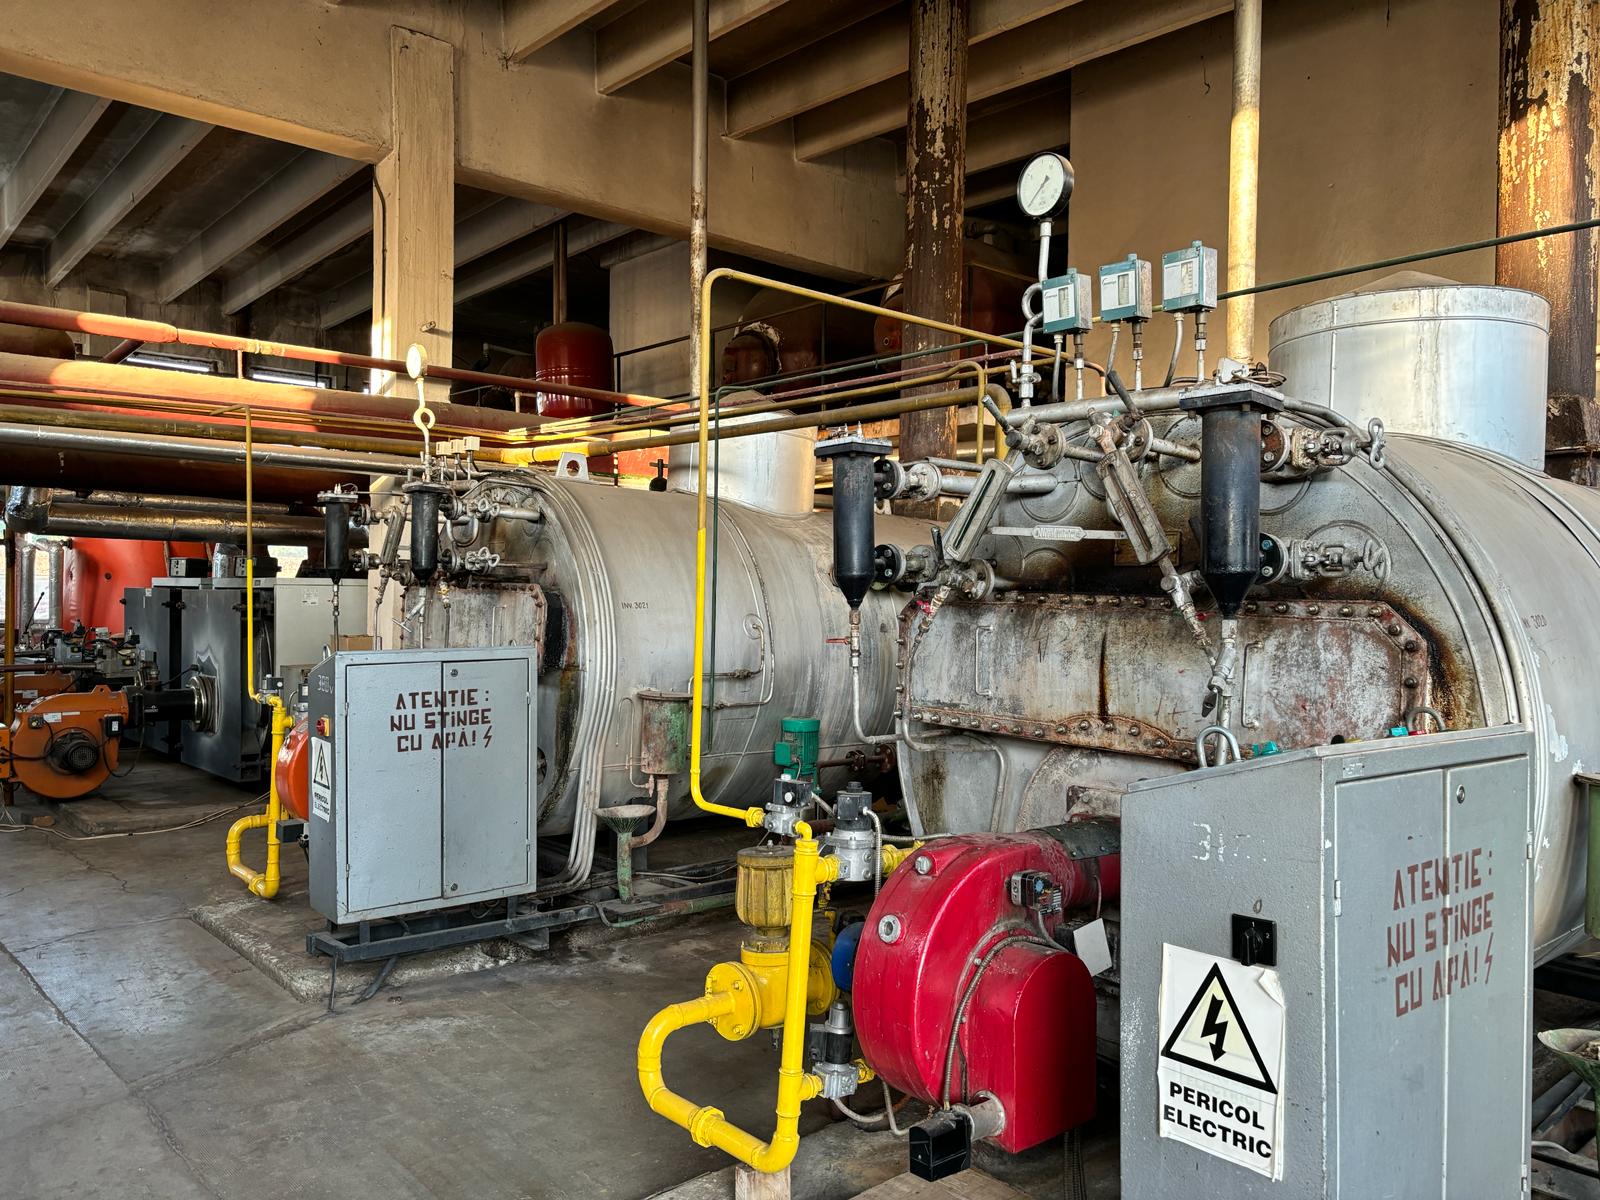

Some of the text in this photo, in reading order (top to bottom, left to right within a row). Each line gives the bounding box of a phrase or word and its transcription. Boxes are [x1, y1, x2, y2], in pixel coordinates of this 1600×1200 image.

[390, 714, 416, 732] NU
[397, 734, 422, 753] CU
[1387, 918, 1416, 968] NU
[1395, 967, 1423, 1018] CU
[1169, 1081, 1265, 1131] PERICOL
[1163, 1104, 1272, 1159] ELECTRIC
